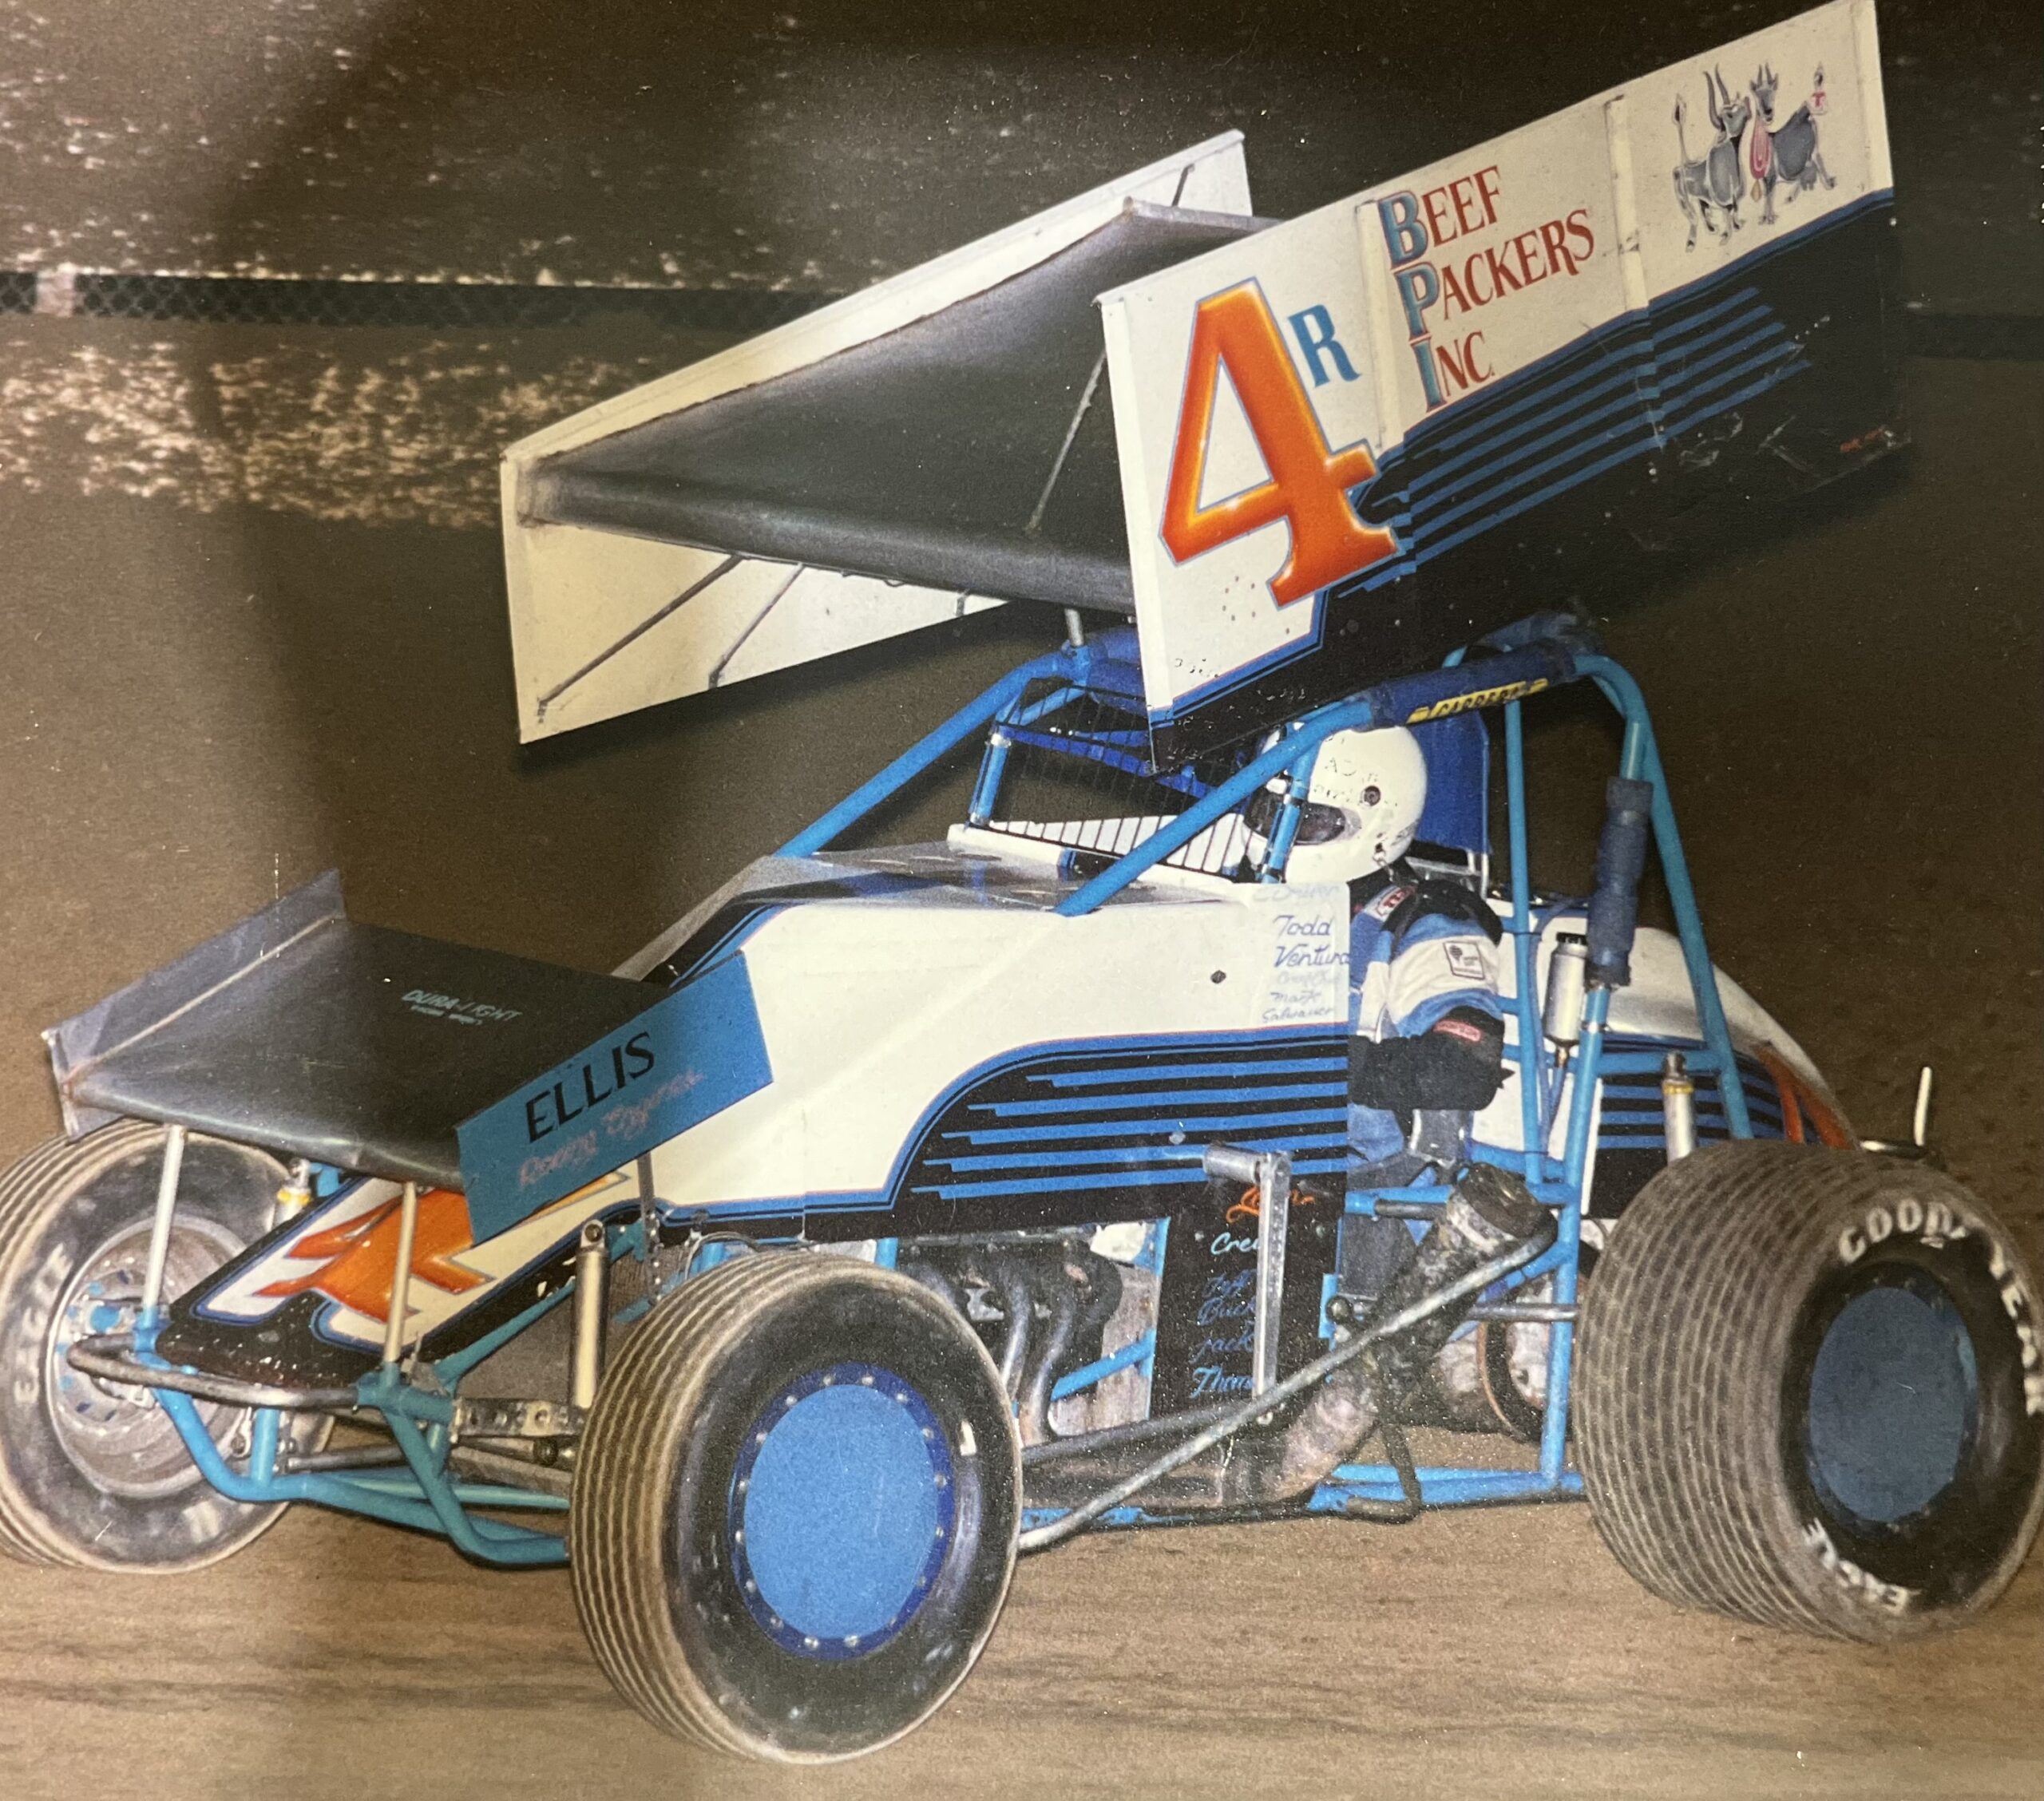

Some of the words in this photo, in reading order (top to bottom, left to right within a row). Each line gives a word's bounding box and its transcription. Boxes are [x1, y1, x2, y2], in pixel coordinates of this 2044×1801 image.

[1377, 166, 1500, 270] BEEF
[1392, 208, 1595, 342] PACKERS
[1157, 276, 1400, 611] 4
[1287, 303, 1362, 388] R
[1272, 914, 1335, 939] Todd
[525, 1031, 656, 1143] ELLIS
